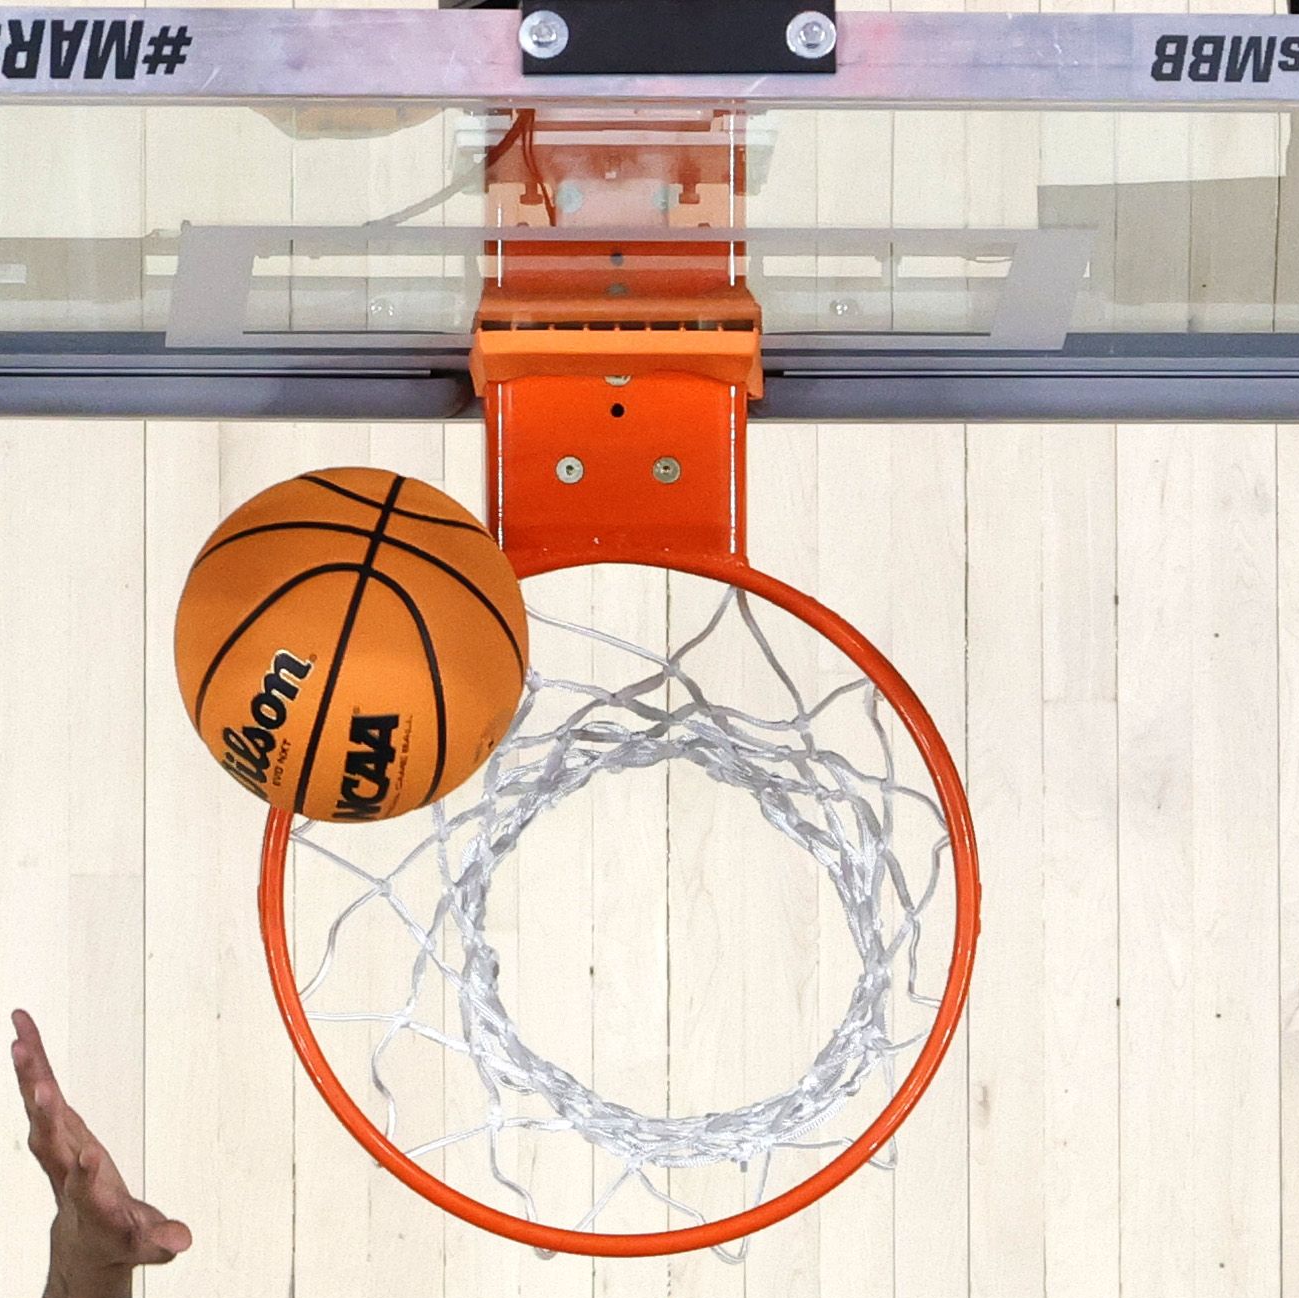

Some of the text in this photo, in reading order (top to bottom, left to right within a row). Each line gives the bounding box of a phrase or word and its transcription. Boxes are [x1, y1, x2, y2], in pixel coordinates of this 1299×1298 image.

[402, 714, 414, 754] BALL
[272, 739, 292, 787] EVO NXT
[332, 714, 400, 820] NCAA
